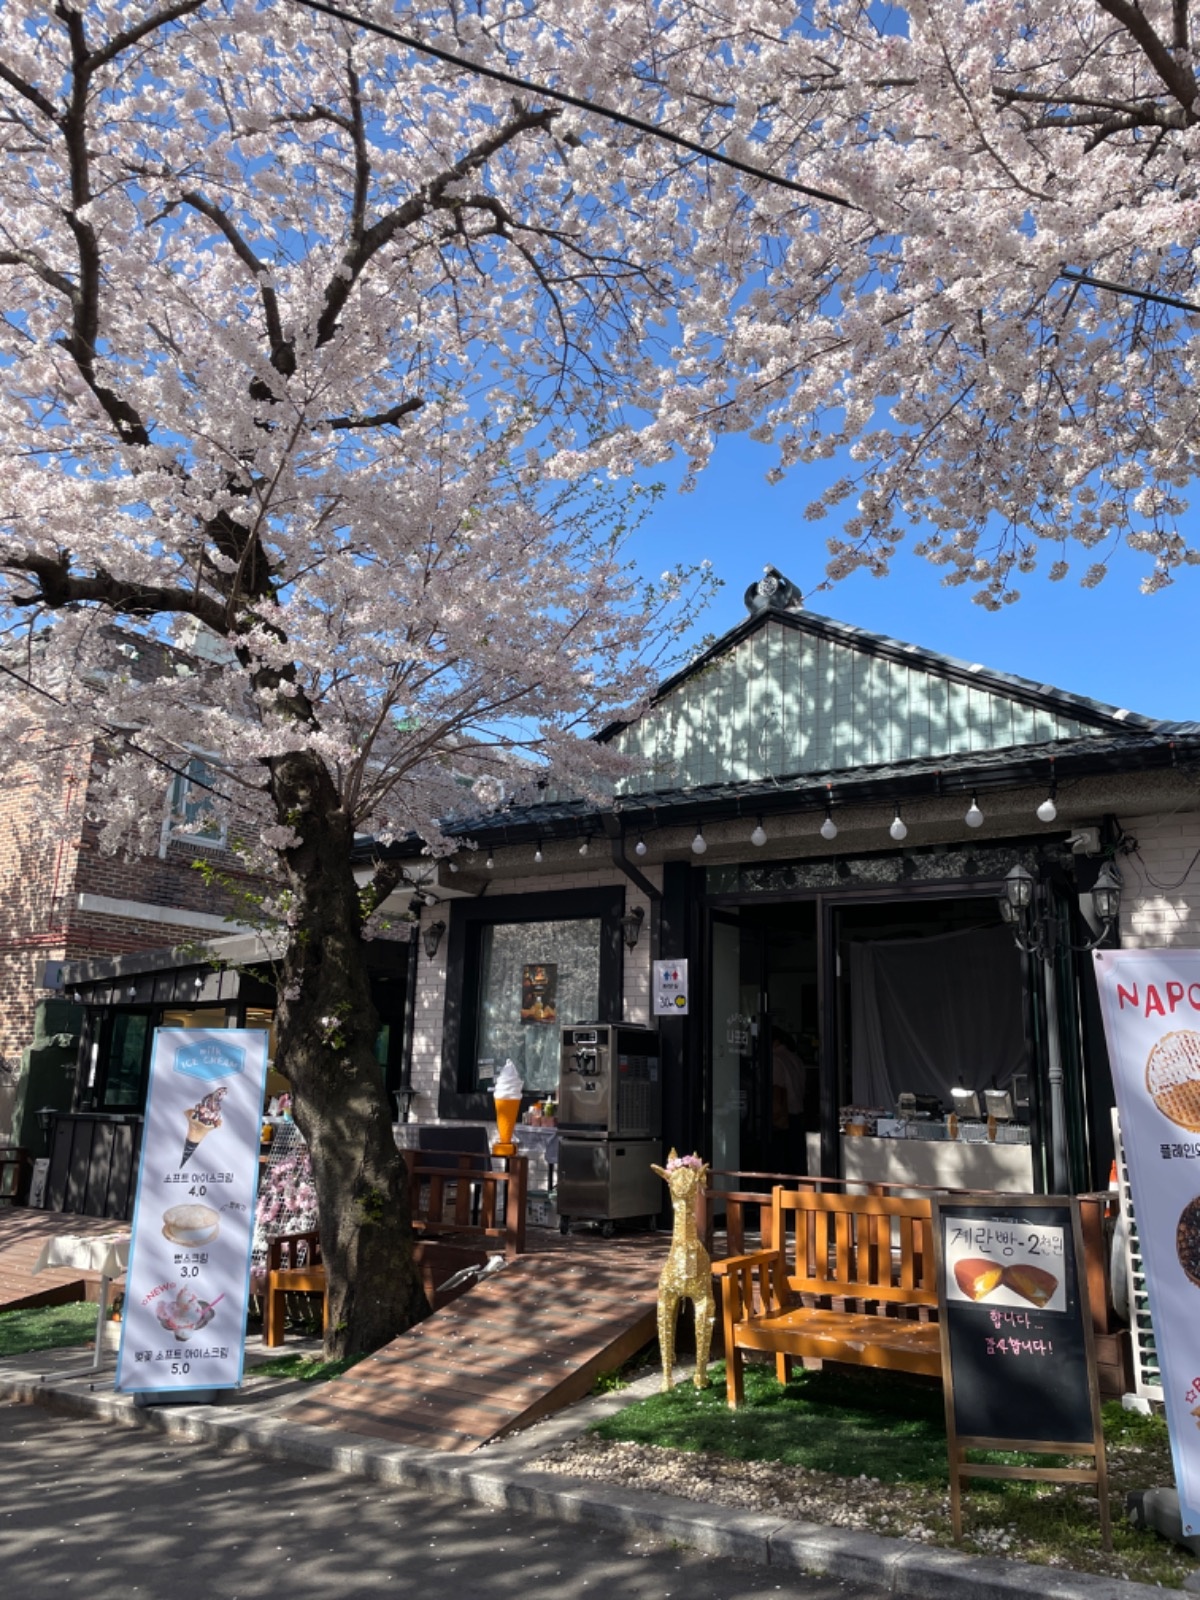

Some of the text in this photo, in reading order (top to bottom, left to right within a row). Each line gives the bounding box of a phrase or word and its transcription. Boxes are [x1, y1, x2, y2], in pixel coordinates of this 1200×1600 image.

[163, 1172, 234, 1184] 소프트 아이스크림
[188, 1185, 207, 1197] 4.0
[180, 1266, 199, 1278] 3.0
[155, 1348, 182, 1360] 소프트
[184, 1347, 229, 1359] 아이스크림
[171, 1362, 190, 1375] 5.0
